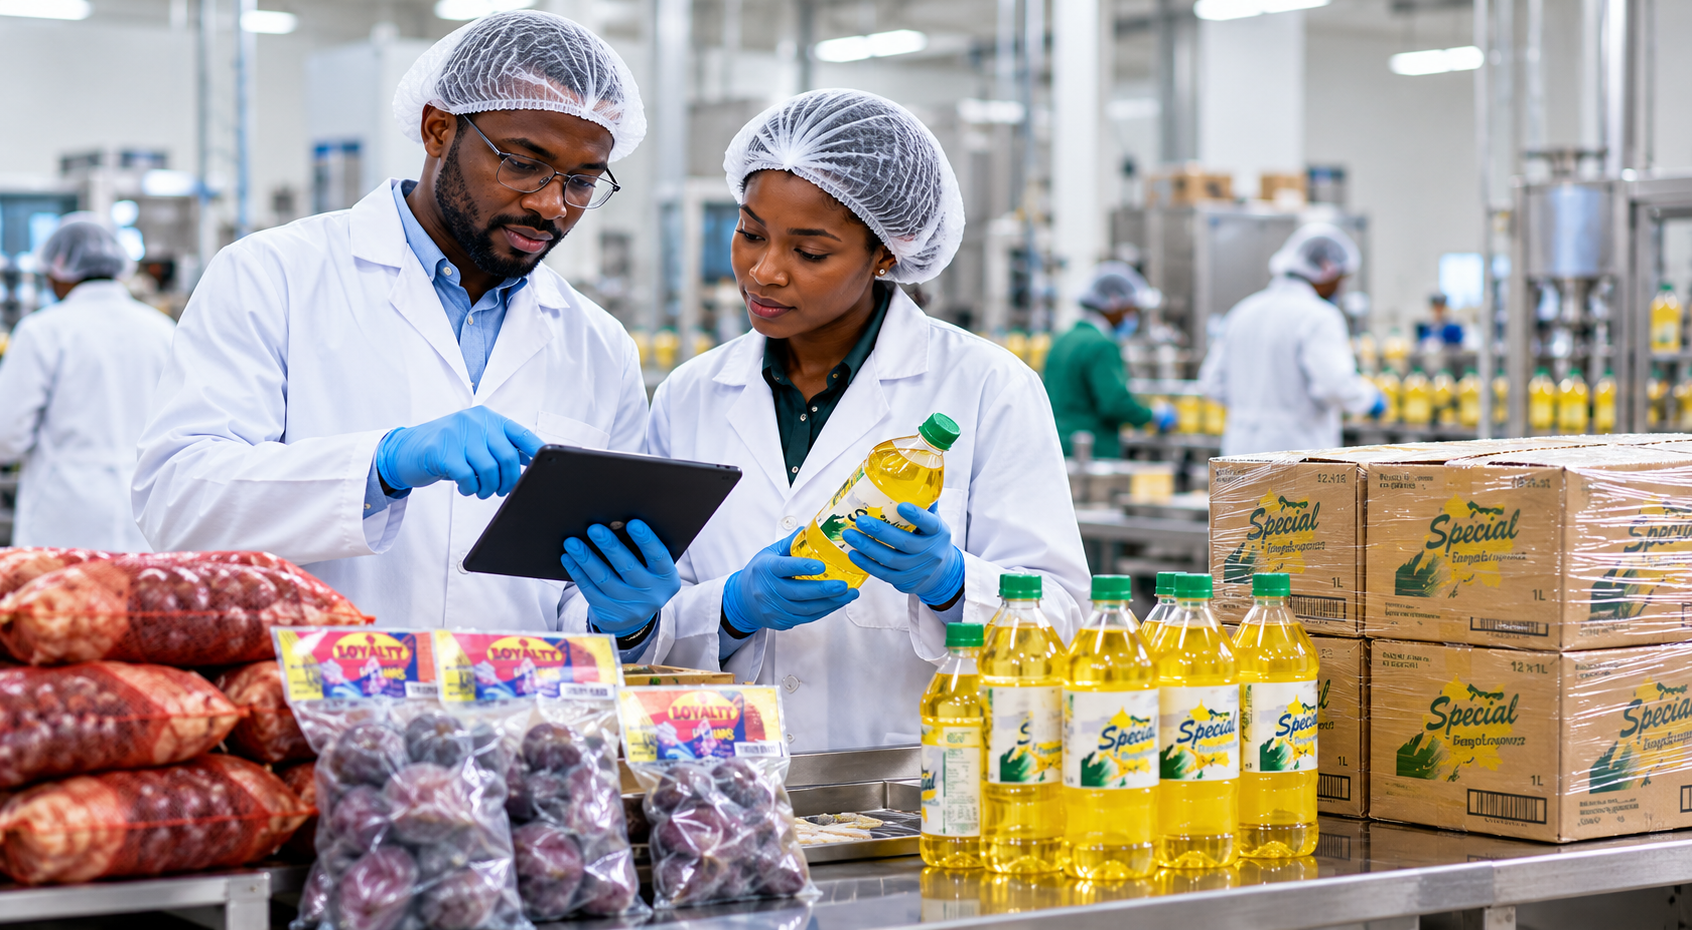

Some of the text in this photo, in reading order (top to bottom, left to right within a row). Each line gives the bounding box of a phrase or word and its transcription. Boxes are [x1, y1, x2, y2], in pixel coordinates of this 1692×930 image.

[1331, 576, 1344, 588] 1L
[1531, 588, 1546, 601] 1L
[335, 644, 404, 660] LOYALTY
[492, 646, 560, 662] LOYALTY
[1510, 660, 1524, 673] 12
[671, 704, 734, 720] LOYALTY
[1619, 697, 1692, 740] Specia
[1530, 774, 1544, 787] 1L
